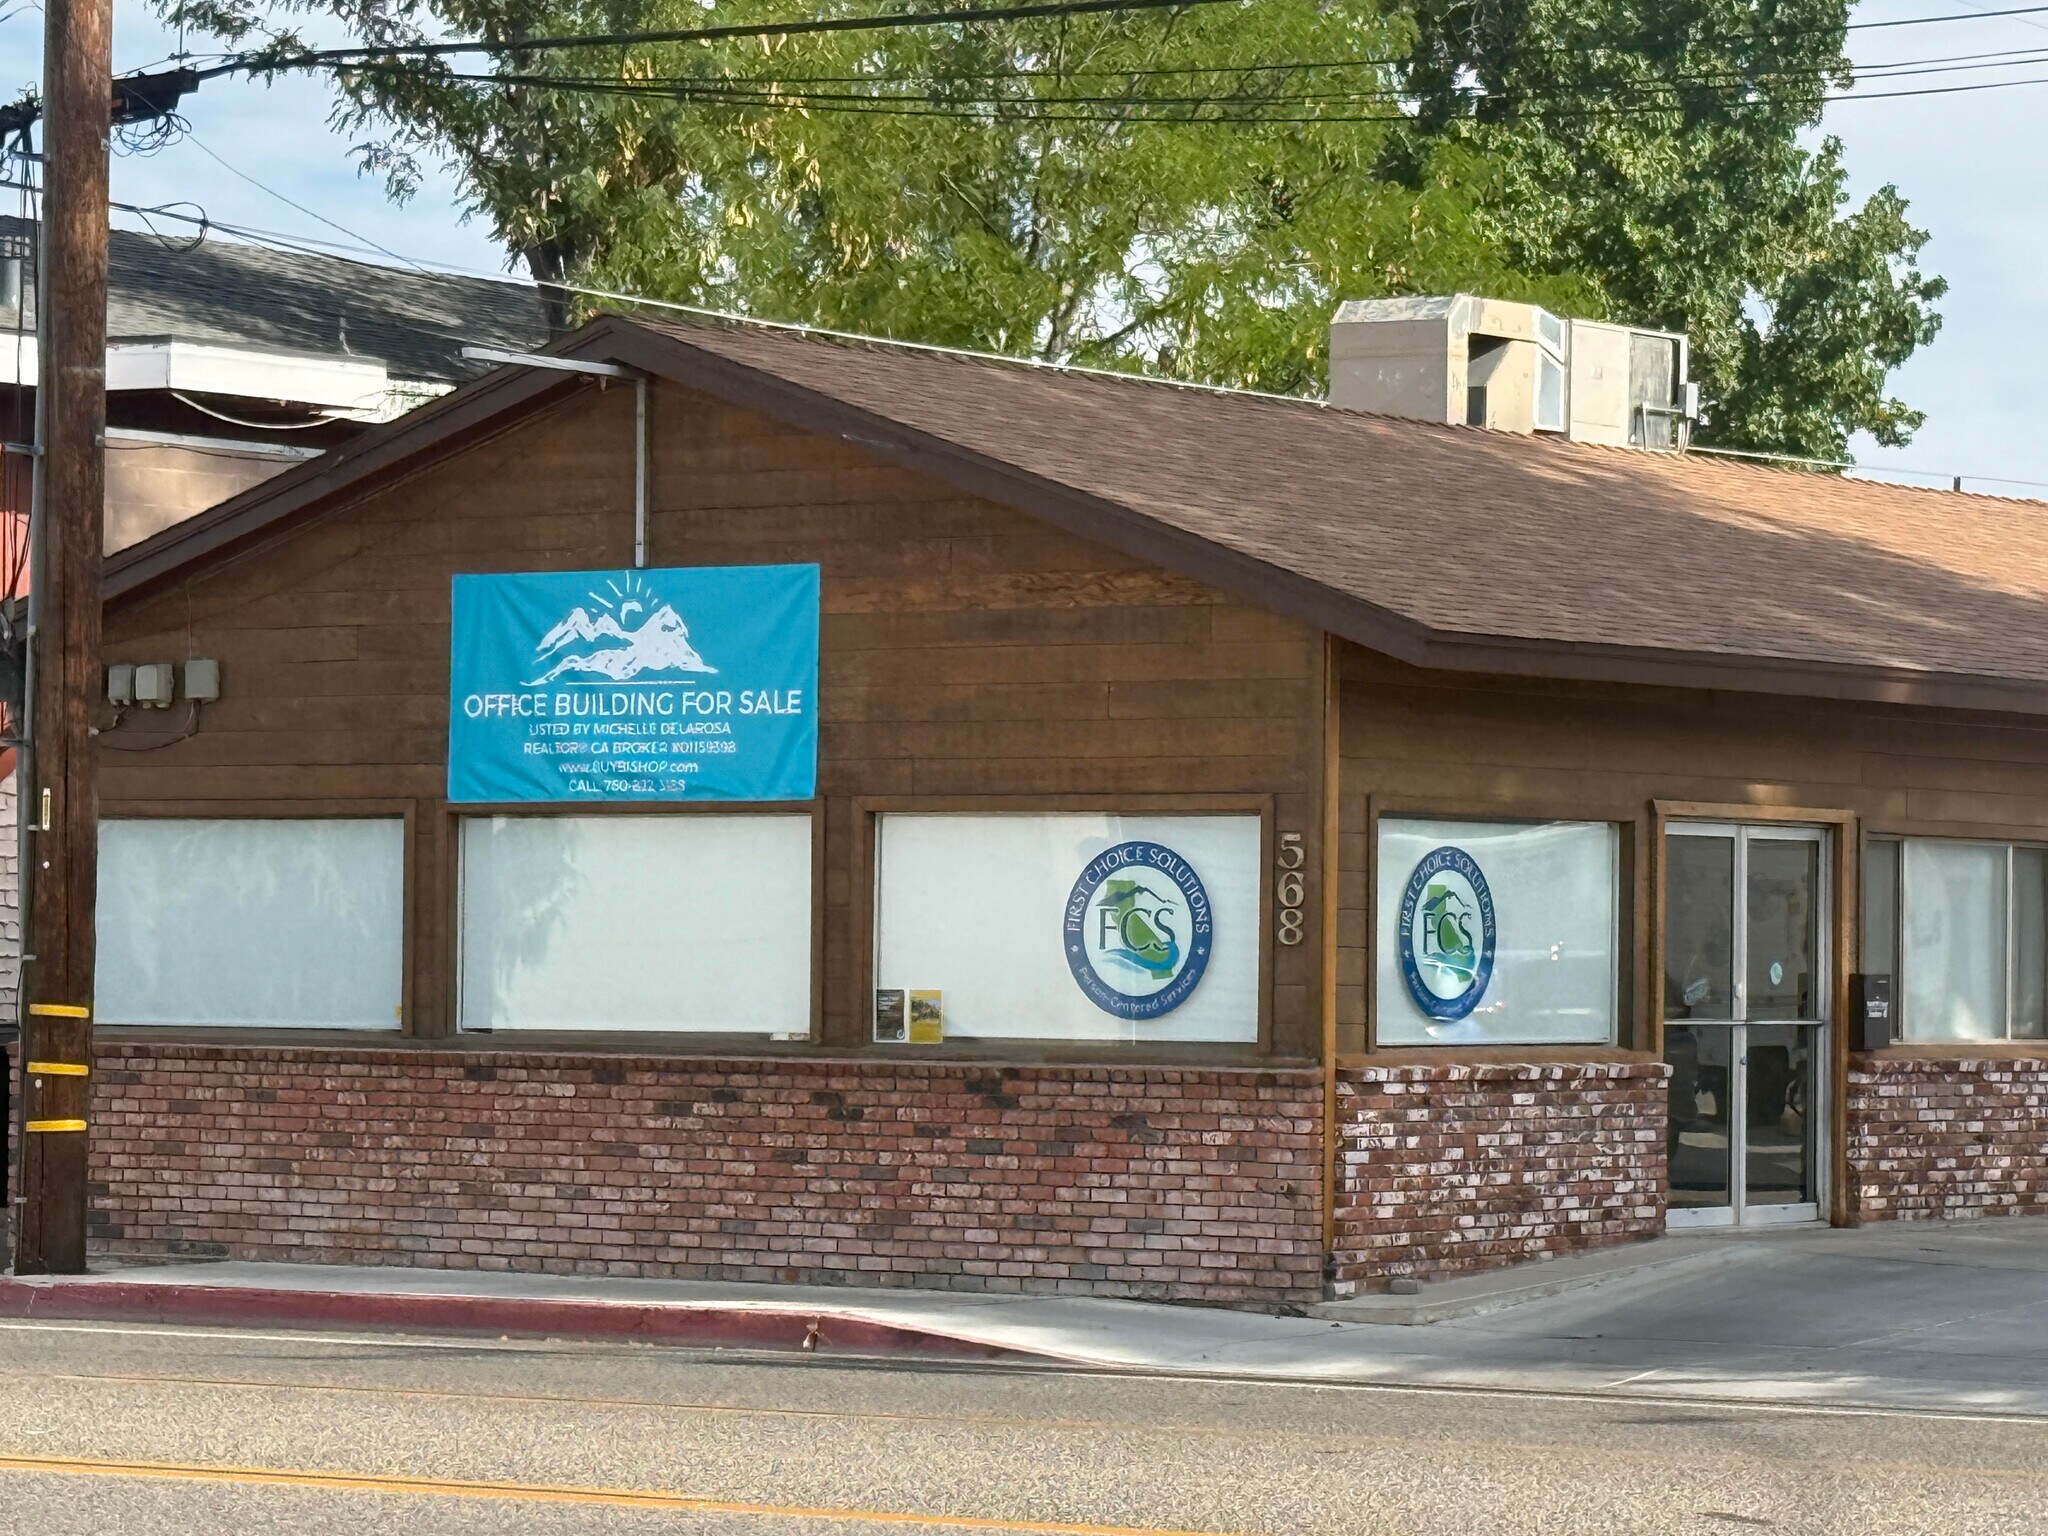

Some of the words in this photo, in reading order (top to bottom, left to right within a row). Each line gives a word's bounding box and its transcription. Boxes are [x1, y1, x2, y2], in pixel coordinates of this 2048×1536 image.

[463, 692, 549, 719] OFFICE
[554, 691, 674, 718] BUILDING
[682, 690, 732, 716] FOR
[738, 689, 802, 715] SALE
[528, 722, 570, 736] LISTED
[573, 722, 591, 736] BY
[593, 721, 657, 736] MICHELLE
[590, 741, 609, 754] CA
[612, 740, 668, 754] BROKER
[568, 778, 603, 793] CALL
[1066, 887, 1089, 932] FIRST
[1085, 845, 1145, 886] CHOICE
[1147, 847, 1210, 934] SOLUTIONS
[1277, 832, 1305, 946] 568
[1401, 888, 1417, 936] FIRST
[1412, 850, 1453, 891] CHOICE
[1454, 853, 1495, 938] SOLUTIONS
[1098, 907, 1178, 952] FCS
[1422, 911, 1474, 955] FCS
